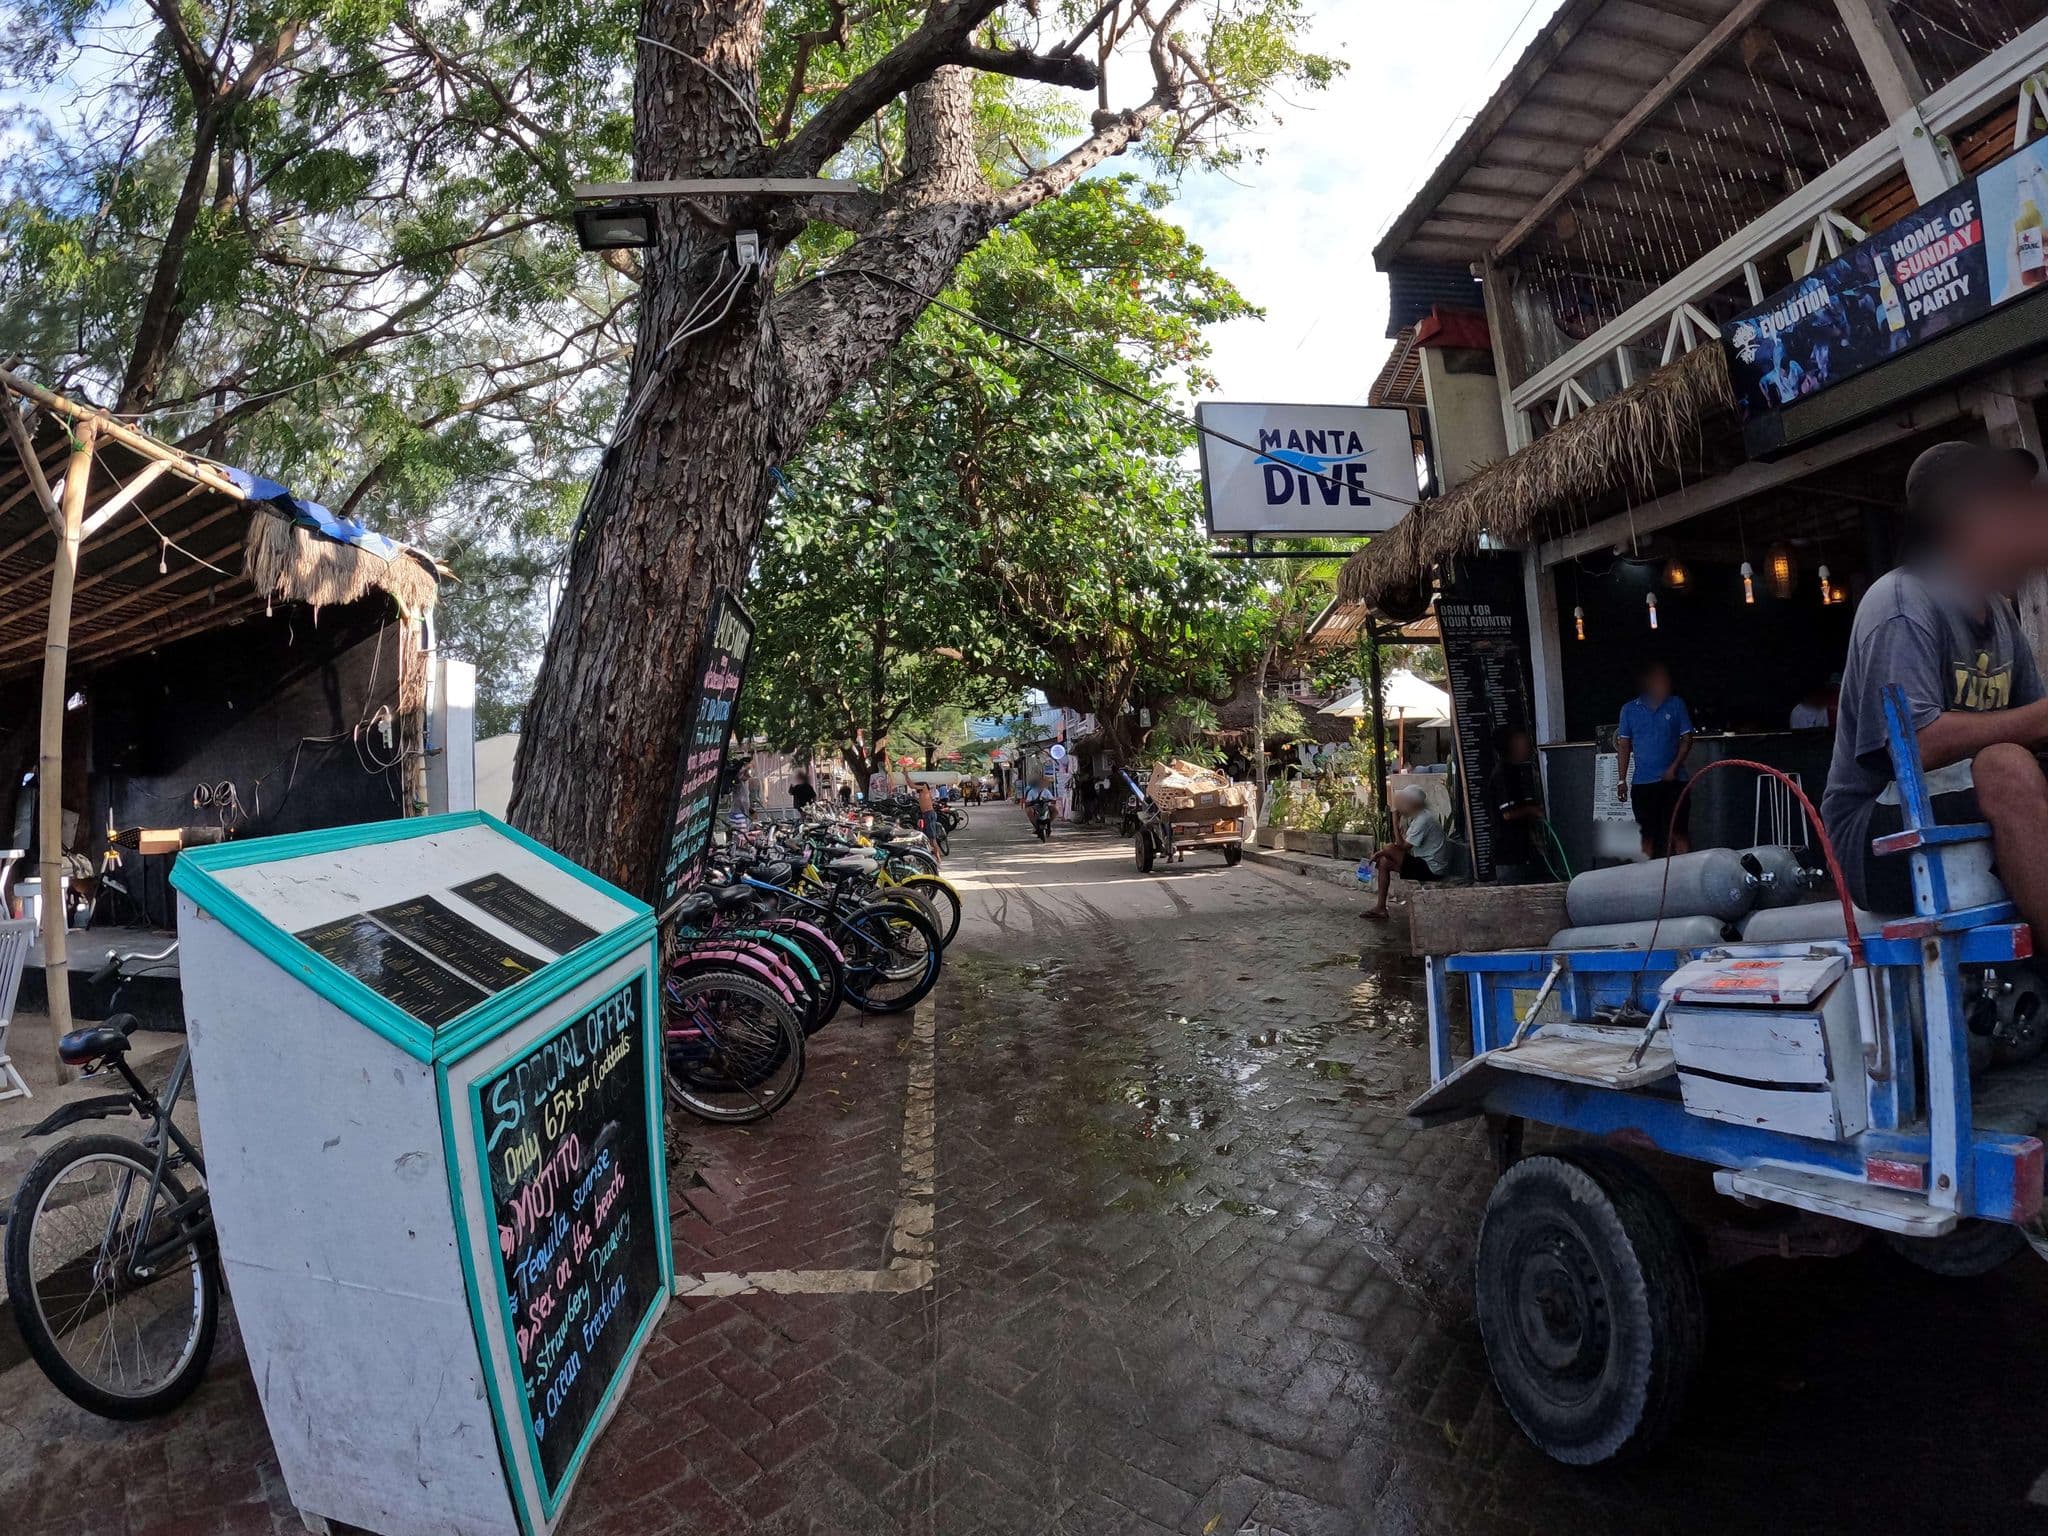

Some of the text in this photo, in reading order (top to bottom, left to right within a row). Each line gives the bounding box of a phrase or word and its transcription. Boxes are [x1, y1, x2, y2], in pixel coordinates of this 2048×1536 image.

[1890, 200, 1975, 261] HOME OF
[1897, 225, 1974, 281] SUNDAY
[1902, 257, 1961, 301] NIGHT
[1908, 274, 1971, 321] PARTY
[1759, 284, 1832, 339] EVOLUTION
[1259, 428, 1364, 454] MANTA
[1263, 463, 1371, 506] DIVE
[1440, 604, 1491, 616] DRINK FOR
[1442, 616, 1512, 627] YOUR COUNTRY
[487, 985, 635, 1152] SPECIAL OFFER
[576, 1074, 590, 1111] for
[592, 1031, 632, 1090] Cocktails
[508, 1132, 580, 1246] MOJITO
[556, 1256, 572, 1291] on
[572, 1219, 593, 1265] the
[594, 1160, 625, 1230] beach
[513, 1211, 570, 1301] Tequila
[582, 1273, 627, 1354] Erection
